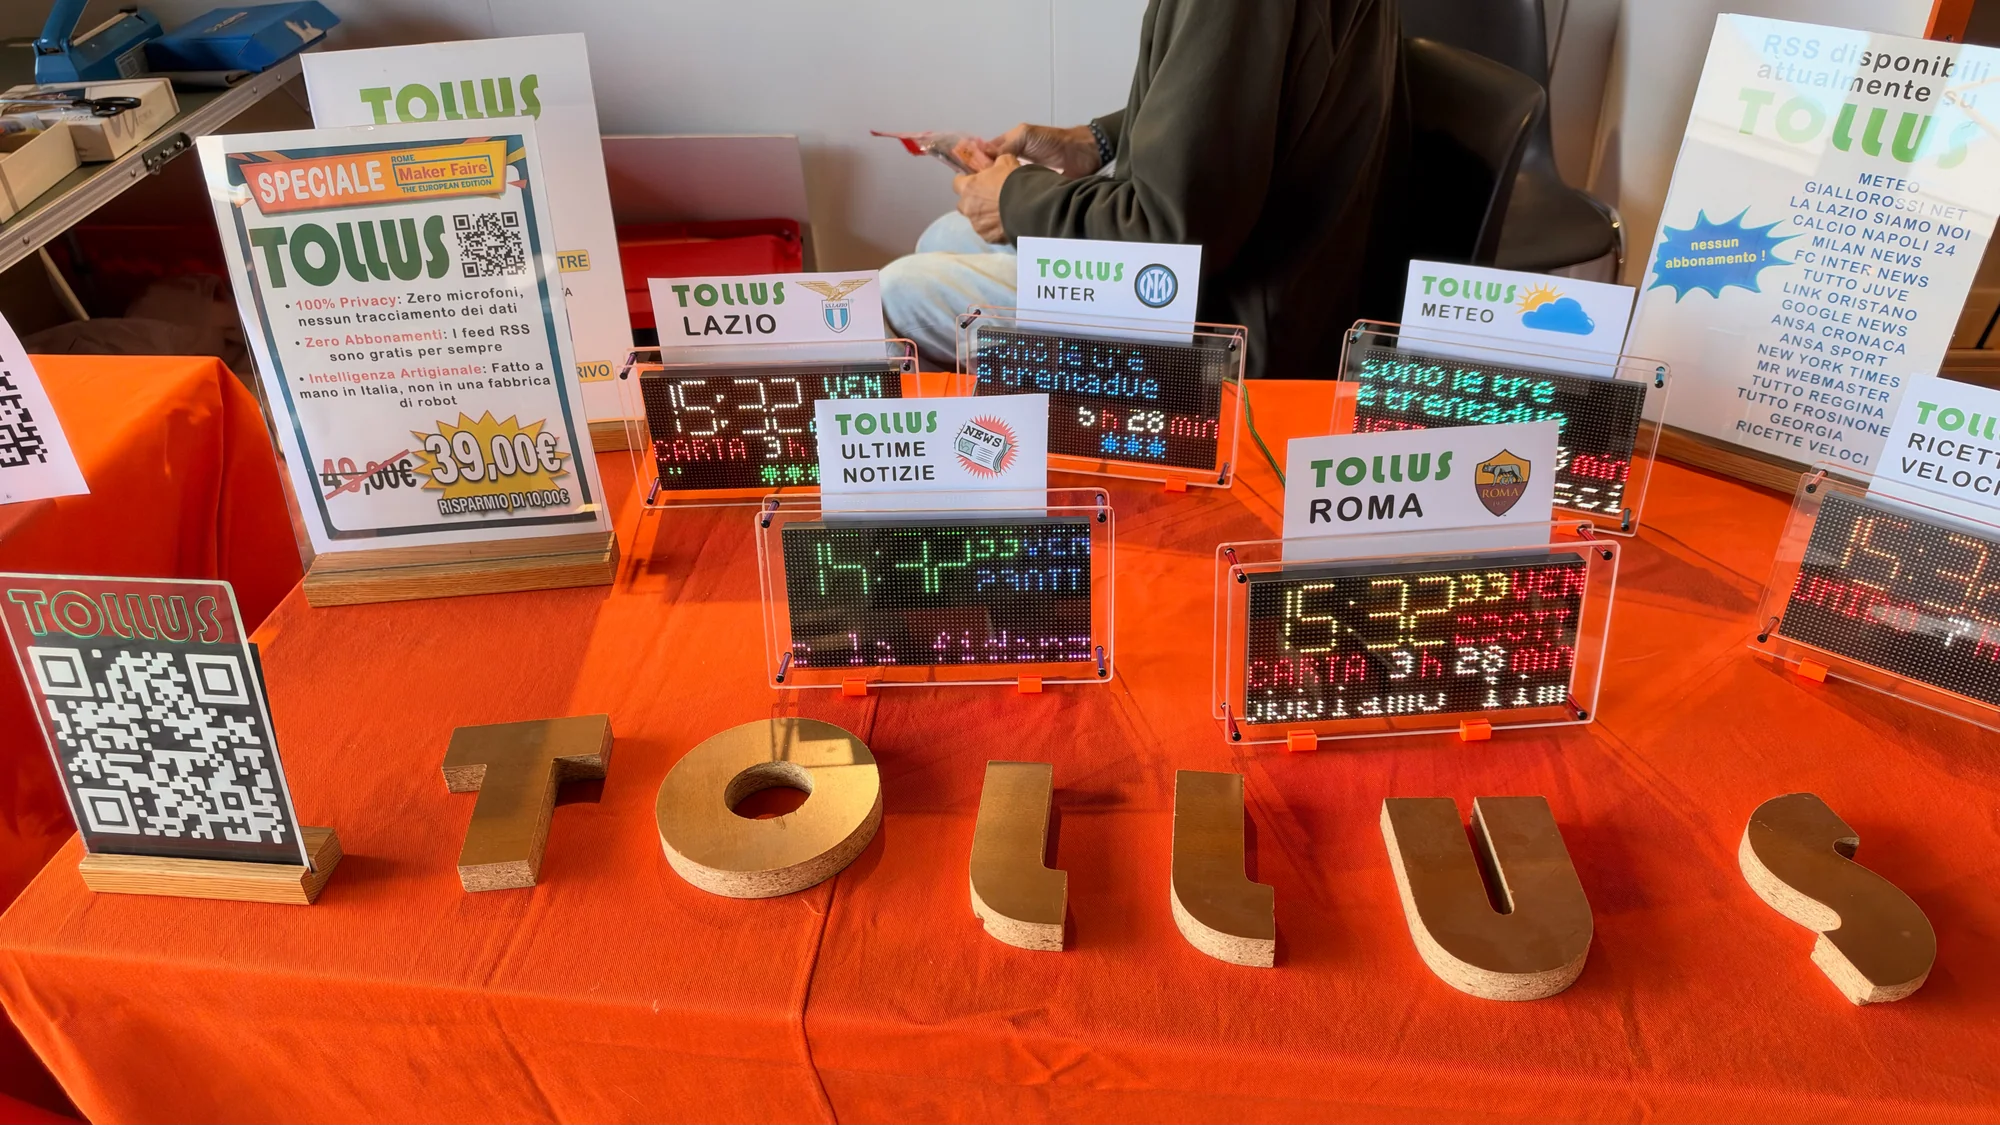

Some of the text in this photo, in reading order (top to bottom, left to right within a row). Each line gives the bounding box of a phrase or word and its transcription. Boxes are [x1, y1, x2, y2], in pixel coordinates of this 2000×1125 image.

[1763, 34, 1991, 83] RSS disponibili
[359, 74, 541, 124] TOLLUS
[1757, 62, 1976, 108] attualmente su
[1738, 87, 1980, 169] TOLLUS
[391, 154, 415, 163] ROME
[398, 162, 488, 182] Maker Faire
[258, 160, 386, 205] SPECIALE
[418, 182, 459, 192] EUROPEAN
[461, 179, 492, 188] EDITION
[1858, 173, 1920, 194] METEO
[1805, 181, 1968, 221] GIALLOROSSI NET
[1790, 196, 1971, 241] LA LAZIO SIAMO NOI
[1691, 238, 1739, 250] nessun
[1793, 214, 1956, 256] CALCIO NAPOLI 24
[249, 214, 450, 288] TOLLUS
[558, 254, 589, 269] TRE
[1665, 252, 1756, 268] abbonamento
[1812, 236, 1922, 268] MILAN NEWS
[1037, 258, 1124, 282] TOLLUS
[1794, 250, 1929, 288] FC INTER NEWS
[296, 287, 524, 311] 100% Privacy: Zero microfoni,
[672, 282, 785, 307] TOLLUS
[1037, 285, 1095, 302] INTER
[1421, 276, 1516, 303] TOLLUS
[1803, 269, 1909, 302] TUTTO JUVE
[298, 303, 518, 326] nessun tracciamento dei dati
[1422, 303, 1494, 323] METEO
[1783, 282, 1917, 321] LINK ORISTANO
[683, 314, 777, 335] LAZIO
[1782, 299, 1908, 336] GOOGLE NEWS
[304, 336, 340, 348] Zero
[345, 328, 448, 346] Abbonamenti:
[462, 326, 494, 338] feed
[500, 324, 530, 336] RSS
[1772, 314, 1905, 354] ANSA CRONACA
[330, 342, 502, 362] sono gratis per sempre
[1780, 333, 1887, 366] ANSA SPORT
[309, 361, 544, 384] Intelligenza Artigianale: Fatto a
[577, 364, 610, 378] RIVO
[1757, 344, 1900, 388] NEW YORK TIMES
[1757, 360, 1890, 402] MR WEBMASTER
[300, 375, 550, 399] mano in Italia, non in una fabbrica
[1003, 365, 1159, 399] trentadue
[1752, 375, 1884, 419] TUTTO REGGINA
[400, 396, 458, 408] di robot
[1738, 387, 1891, 437] TUTTO FROSINONE
[835, 411, 937, 435] TOLLUS
[1102, 409, 1118, 429] h
[1128, 408, 1164, 433] 28
[1170, 415, 1219, 439] min
[1770, 413, 1843, 441] GEORGIA
[1917, 401, 2000, 440] TOLL
[763, 436, 781, 458] 3
[788, 437, 806, 457] h
[842, 441, 925, 459] ULTIME
[962, 425, 1002, 448] NEWS
[1736, 420, 1869, 466] RICETTE VELOCI
[424, 431, 562, 485] 39,00€
[1310, 451, 1453, 488] TOLLUS
[844, 465, 935, 483] NOTIZIE
[438, 489, 570, 515] RISPARMIO DI 10,00€
[1310, 493, 1424, 523] ROMA
[1482, 488, 1519, 498] ROMA
[7, 588, 224, 645] TOLLUS
[1284, 575, 1457, 654] 15:32
[1248, 642, 1574, 687] CARTA 3 h 28 min
